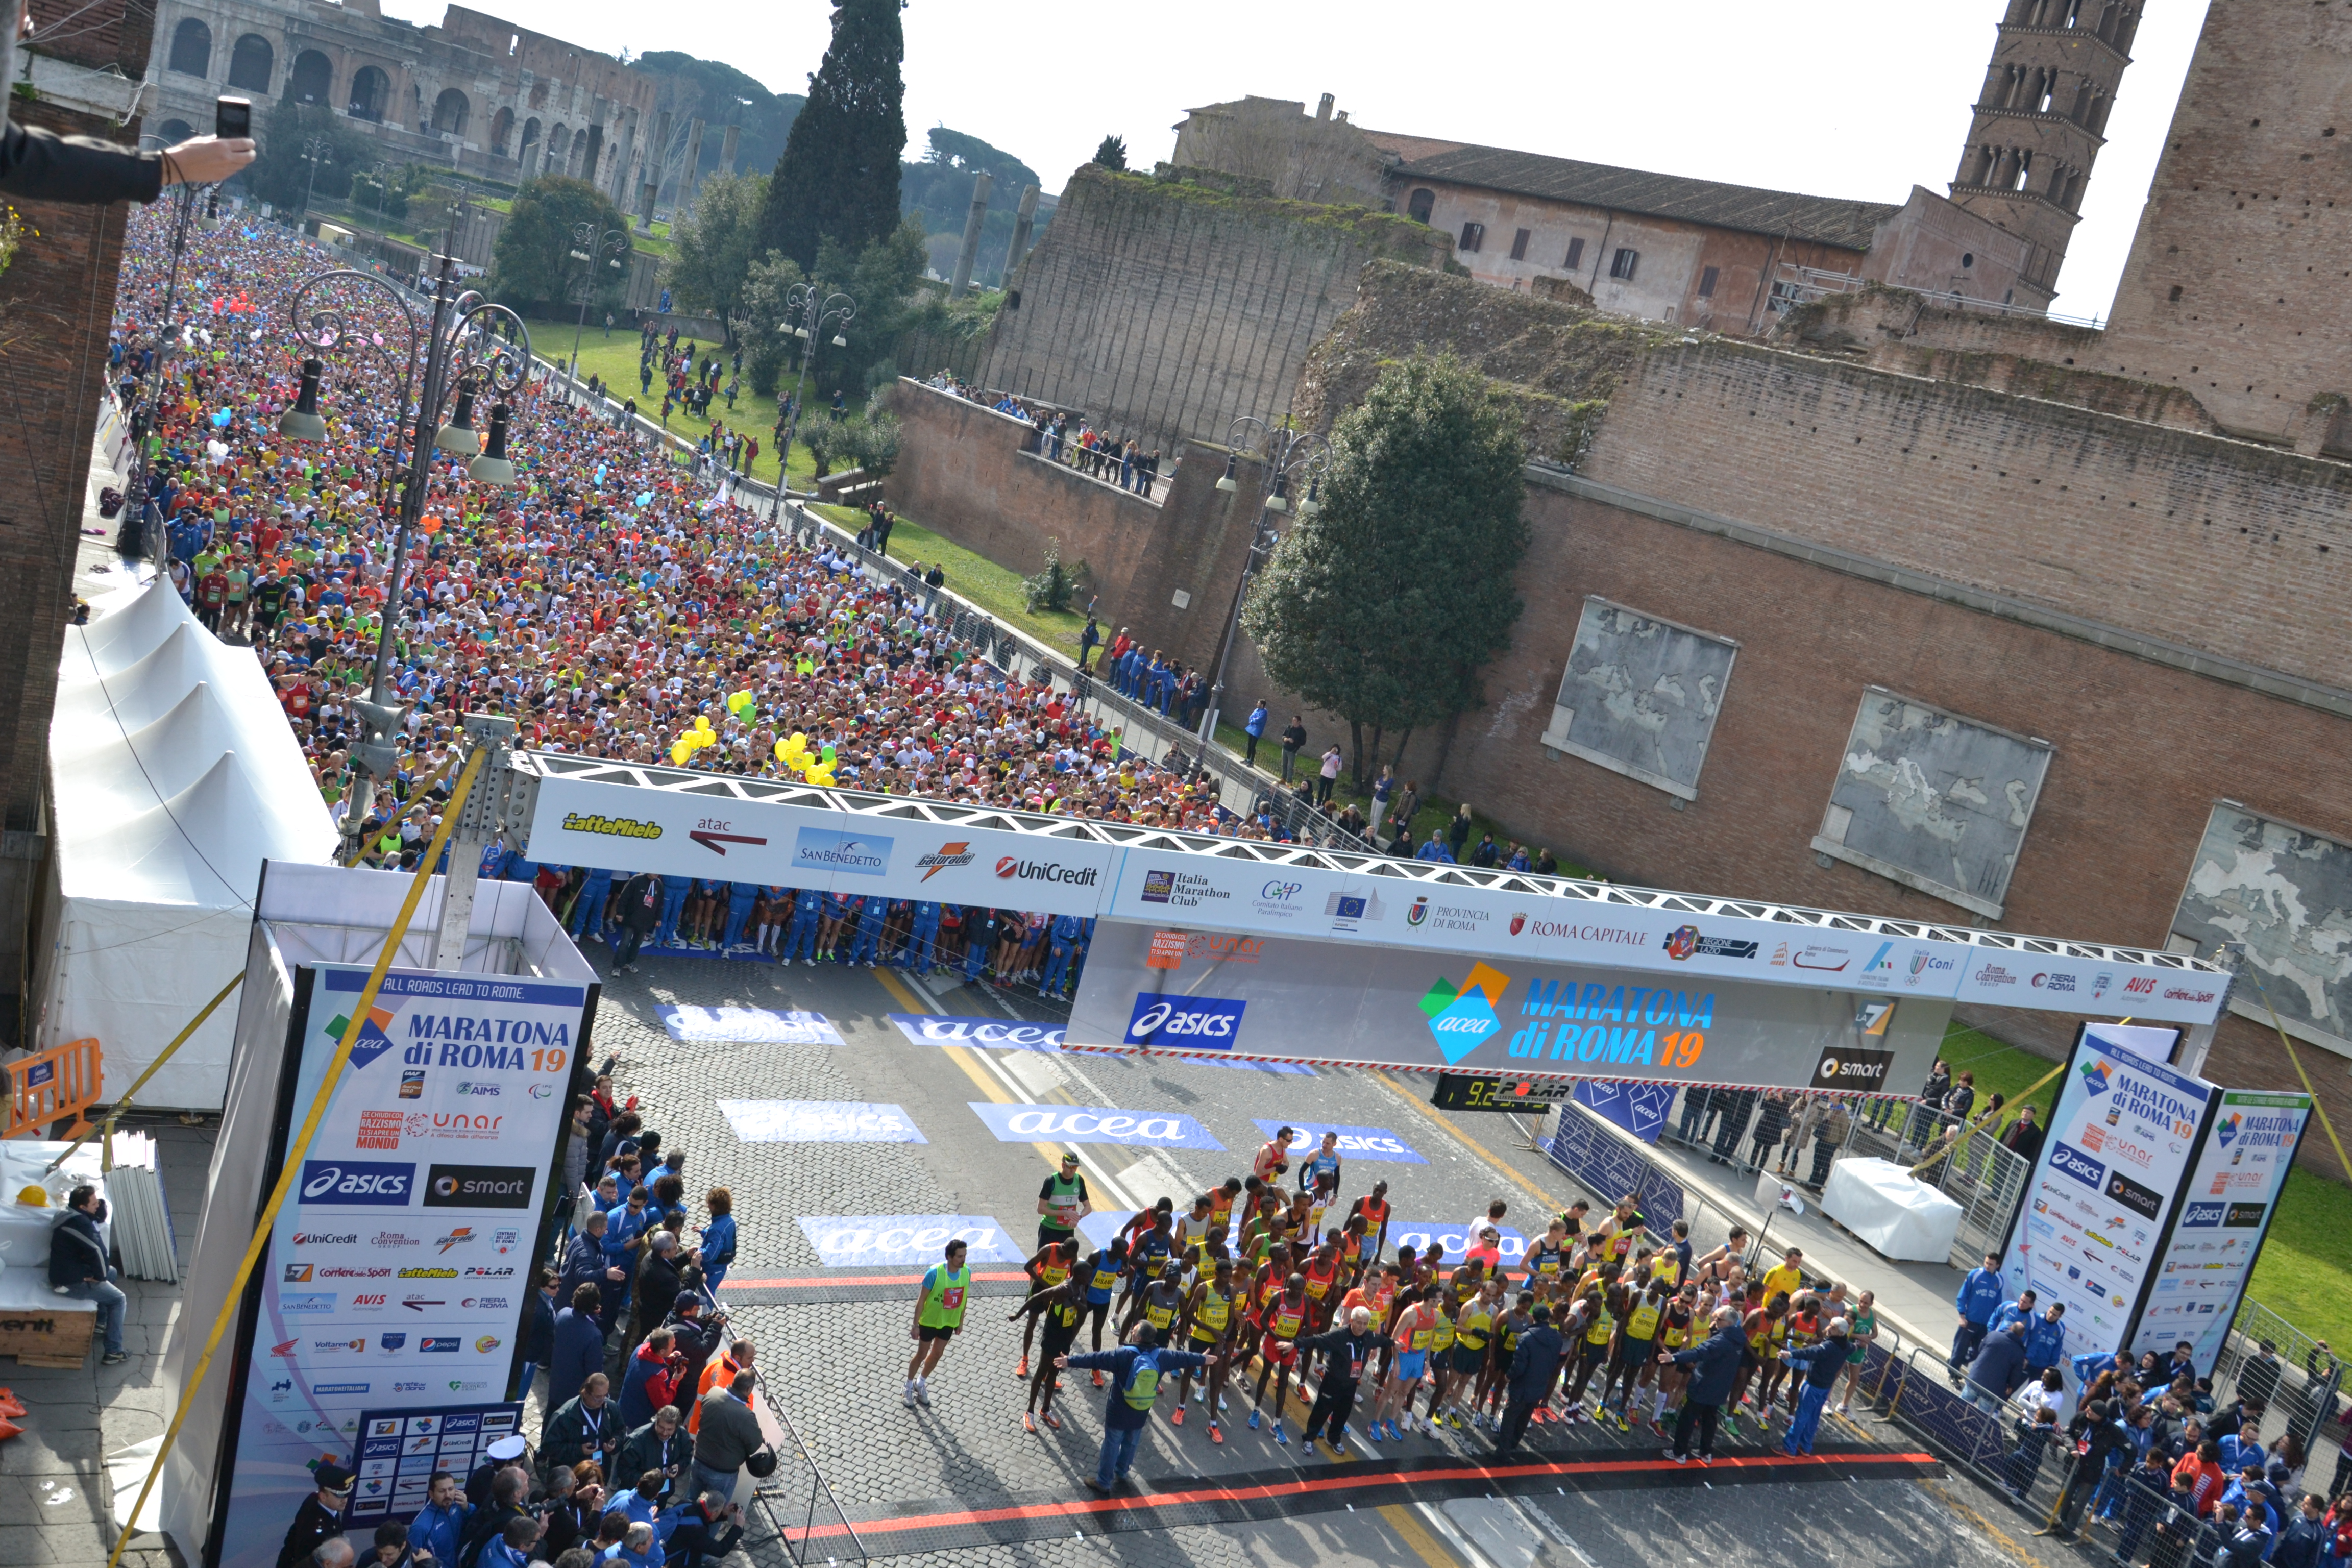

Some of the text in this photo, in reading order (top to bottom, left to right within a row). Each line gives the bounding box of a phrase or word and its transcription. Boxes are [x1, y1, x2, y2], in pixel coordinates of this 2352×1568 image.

[563, 813, 663, 840] LatteMiele
[697, 818, 731, 831] atac
[919, 852, 972, 866] Gatorade
[1018, 860, 1098, 887] UniCredit
[1177, 873, 1208, 885] Italia
[1173, 884, 1230, 899] Marathon
[1171, 895, 1198, 906] Club
[1252, 900, 1302, 911] Comitato Italiano
[1258, 908, 1293, 917] Paralimpico
[1436, 905, 1489, 921] PROVINCIA
[1433, 918, 1476, 932] DI ROMA
[1531, 921, 1648, 946] ROMA CAPITALE
[1152, 939, 1185, 949] RAZZISMO
[1210, 936, 1265, 953] unar
[1702, 936, 1733, 947] REGIONE
[1700, 945, 1721, 955] LAZIO
[1146, 955, 1181, 969] MONDO
[1928, 957, 1954, 970] Coni
[1984, 963, 2006, 974] Roma
[1976, 971, 2016, 984] Convention
[2050, 973, 2076, 983] FIERA
[2123, 977, 2157, 993] AVIS
[384, 978, 525, 999] ALL ROADS LEAD TO ROME.
[2047, 982, 2075, 992] ROMA
[1521, 978, 1716, 1028] MARATONA
[408, 1014, 569, 1046] MARATONA
[1165, 1011, 1235, 1037] asics
[1437, 1016, 1491, 1034] acea
[1509, 1022, 1704, 1068] di ROMA 19
[404, 1041, 566, 1072] di ROMA 19
[2110, 1047, 2120, 1059] ALL
[2121, 1052, 2139, 1068] ROADS
[2139, 1061, 2153, 1074] LEAD
[2153, 1068, 2161, 1077] TO
[1839, 1061, 1883, 1078] smart
[1500, 1082, 1570, 1098] POLAR
[1593, 1082, 1615, 1095] acea
[2086, 1076, 2106, 1089] acea
[470, 1086, 500, 1096] AIMS
[2117, 1074, 2196, 1125] MARATONA
[1635, 1104, 1658, 1119] acea
[2112, 1092, 2192, 1139] di ROMA 19
[361, 1118, 402, 1129] RAZZISMO
[433, 1113, 503, 1130] unar
[1008, 1111, 1185, 1140] acea
[2244, 1116, 2300, 1132] MARATONA
[356, 1137, 399, 1149] MONDO
[2238, 1132, 2295, 1147] di ROMA 19
[2118, 1139, 2153, 1163] unar
[2067, 1157, 2101, 1182] asics
[2238, 1172, 2263, 1181] unar
[338, 1174, 407, 1194] asics
[462, 1178, 524, 1195] smart
[1610, 1171, 1631, 1189] acea
[2047, 1185, 2071, 1202] UniCredit
[2124, 1188, 2157, 1211] smart
[1653, 1202, 1675, 1220] acea
[2238, 1210, 2261, 1219] smart
[307, 1234, 357, 1244] UniCredit
[371, 1237, 420, 1245] Convention
[436, 1235, 474, 1244] Gatorade
[820, 1228, 999, 1254] acea
[2061, 1234, 2077, 1247] AVIS
[2115, 1245, 2141, 1263] POLAR
[398, 1268, 458, 1278] LatteMiele
[464, 1267, 514, 1276] POLAR
[1045, 1273, 1062, 1284] KORIR
[353, 1294, 387, 1305] AVIS
[1149, 1313, 1168, 1324] KANDA
[1278, 1323, 1297, 1333] OLOISA
[2061, 1357, 2070, 1367] 19
[1903, 1384, 1929, 1405] acea
